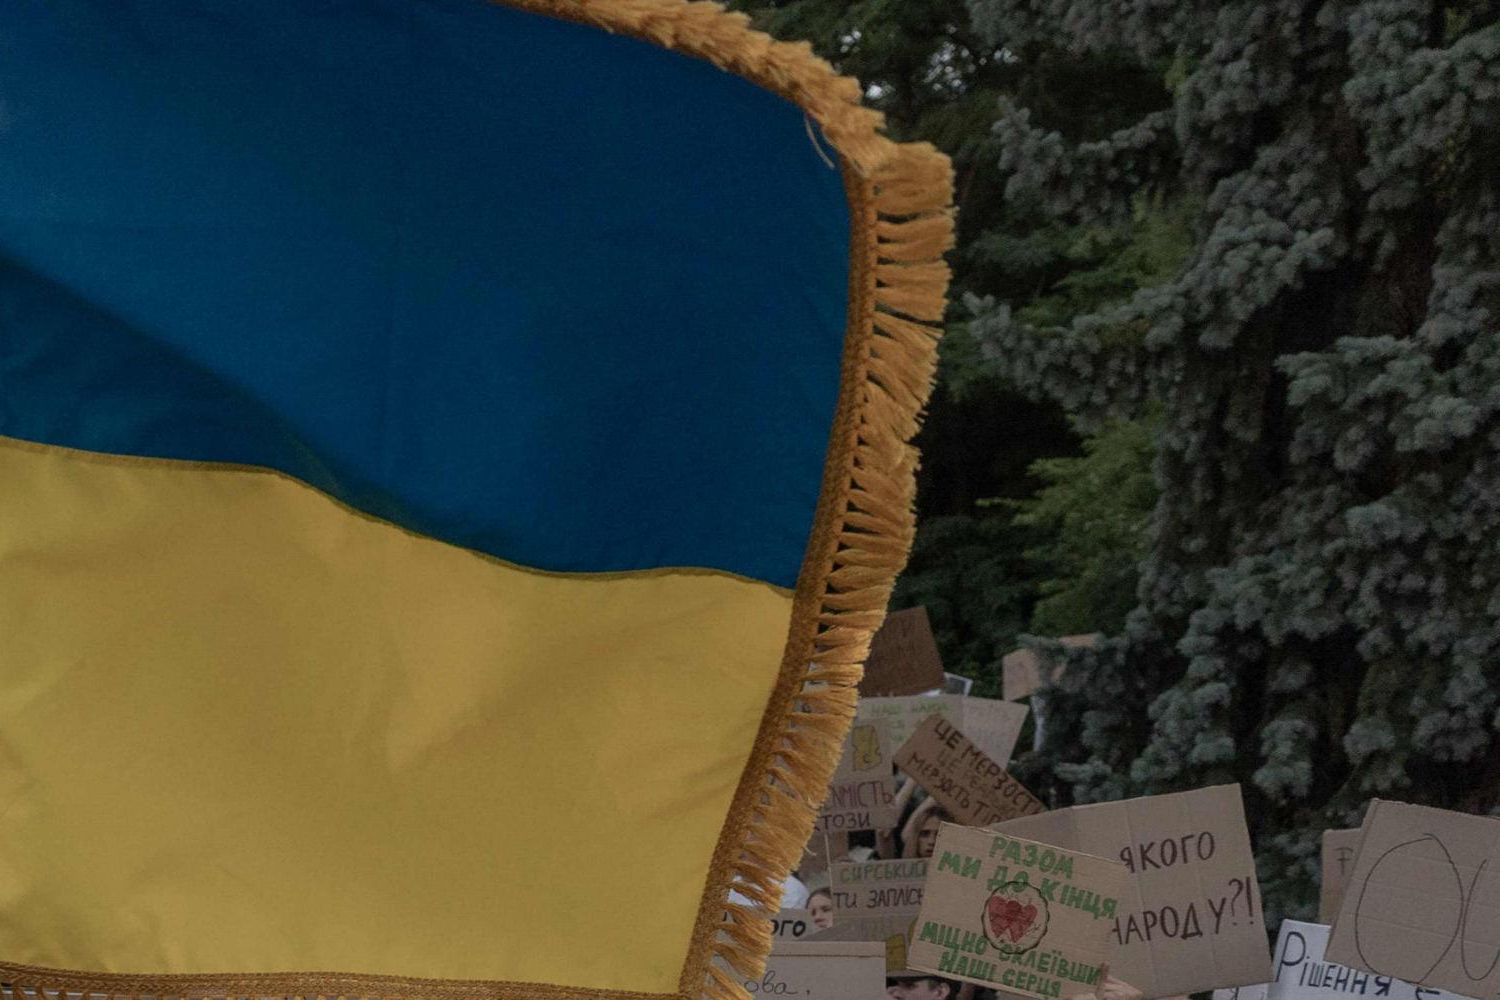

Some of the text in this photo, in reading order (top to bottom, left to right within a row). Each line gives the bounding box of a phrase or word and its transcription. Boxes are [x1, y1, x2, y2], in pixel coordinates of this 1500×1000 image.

[989, 836, 1074, 879] РАЗОМ
[1120, 831, 1216, 874] ЯКОГО
[937, 850, 983, 881] МИ
[1040, 877, 1118, 920] КІНЦЯ
[918, 921, 990, 956] МІЦНО
[938, 951, 1063, 1000] НАШІ СЕРЦЯ
